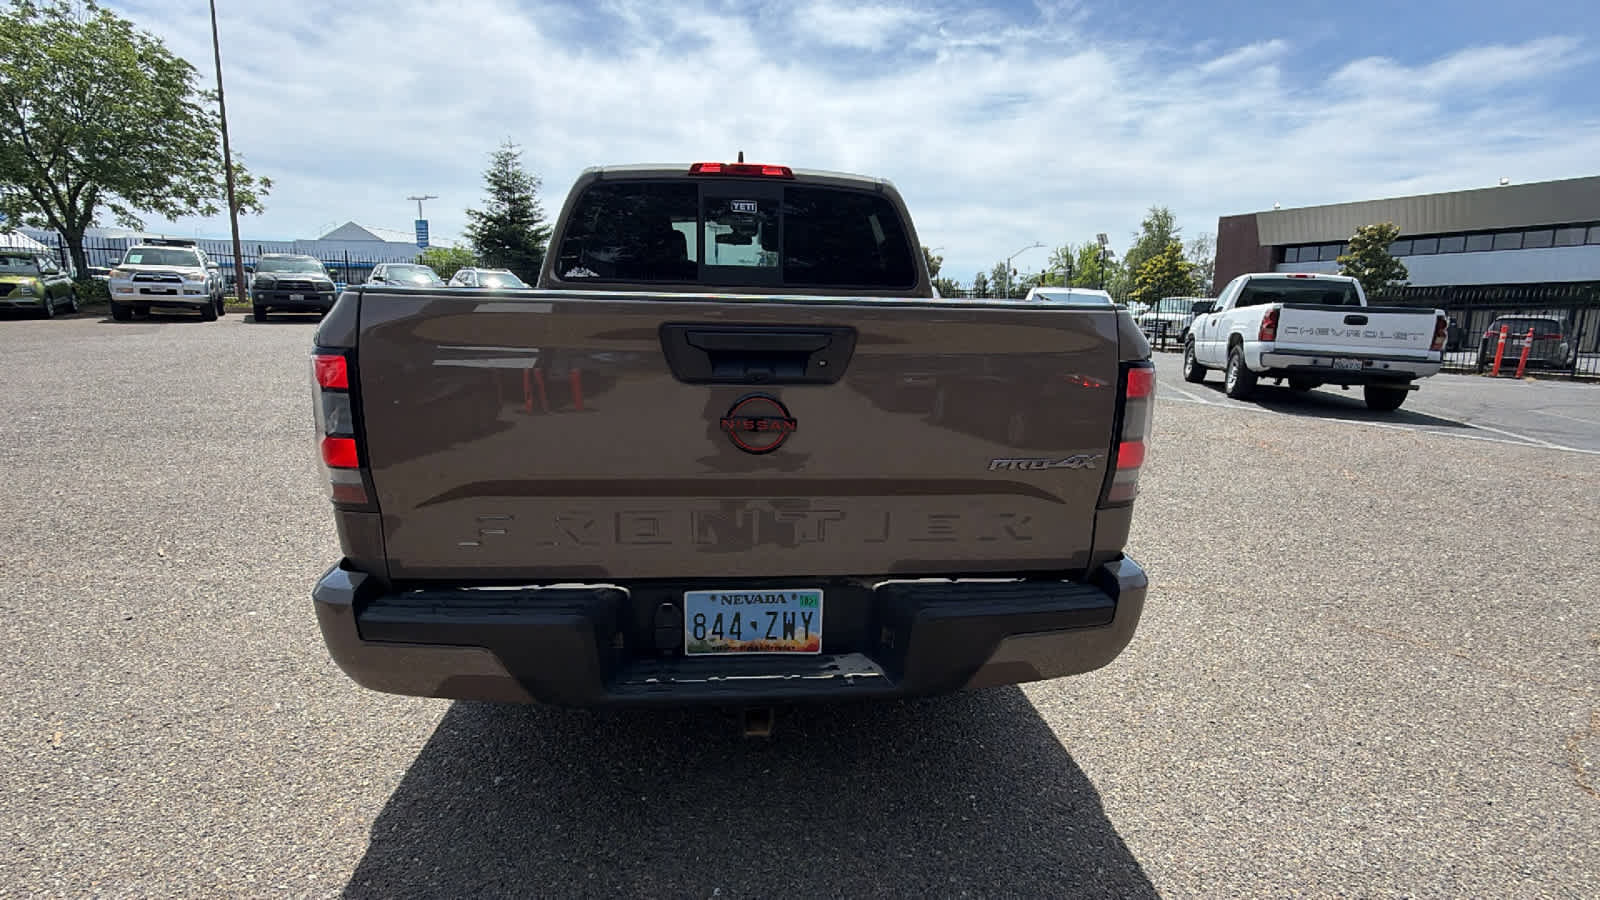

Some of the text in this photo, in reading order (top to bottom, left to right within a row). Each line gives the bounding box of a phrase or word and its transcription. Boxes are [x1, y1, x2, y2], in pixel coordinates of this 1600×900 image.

[733, 202, 755, 211] YETI
[1284, 326, 1425, 341] CHEVROLET
[720, 419, 796, 431] NISSAN
[456, 509, 1033, 547] FRONTIER
[721, 594, 787, 606] NEVADA
[693, 611, 814, 641] 844 ZWY
